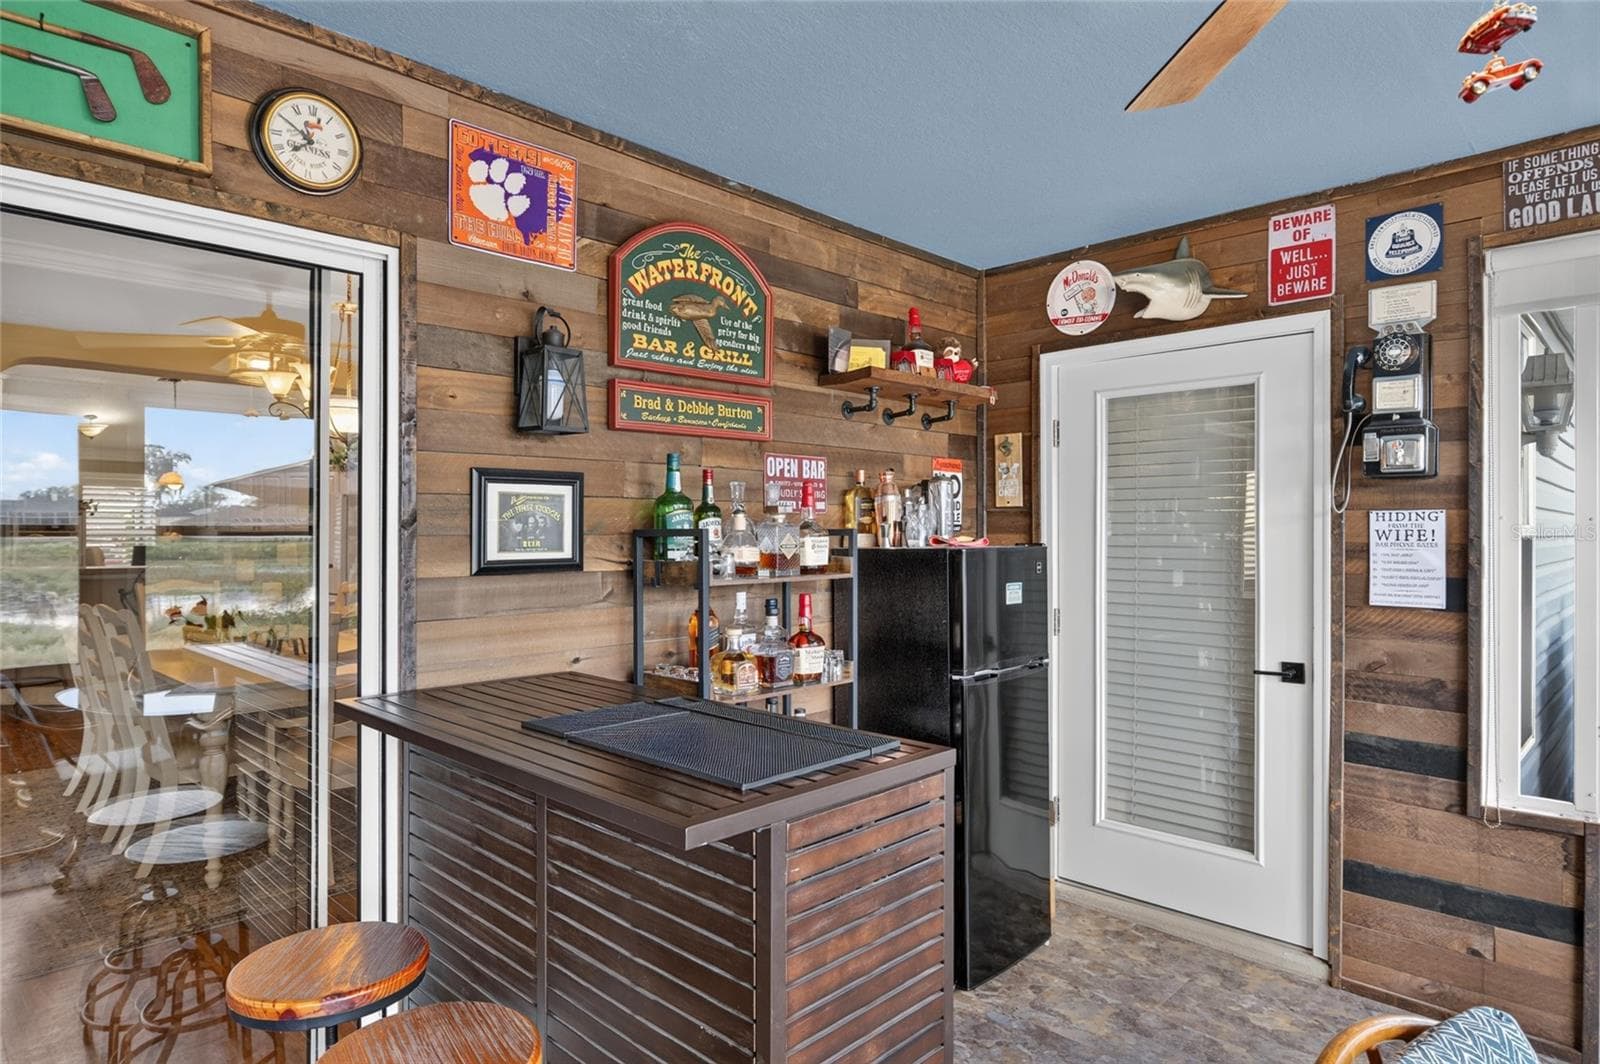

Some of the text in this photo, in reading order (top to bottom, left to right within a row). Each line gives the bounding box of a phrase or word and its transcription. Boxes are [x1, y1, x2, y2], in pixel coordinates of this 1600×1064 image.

[1508, 143, 1599, 172] IF SOMETHING
[1508, 156, 1594, 183] OFFENDS
[1508, 168, 1598, 196] PLEASE LET US
[1524, 191, 1541, 204] WE
[1544, 188, 1565, 200] CAN
[1569, 184, 1587, 197] ALL
[1273, 209, 1331, 232] BEWARE
[1508, 200, 1561, 228] GOOD
[1292, 228, 1311, 242] OF
[679, 243, 701, 259] The
[1280, 247, 1328, 265] WELL...
[1286, 262, 1318, 280] JUST
[627, 258, 758, 318] WATERFRONT
[1277, 276, 1327, 296] BEWARE
[622, 297, 663, 311] great food
[622, 308, 646, 320] drink
[655, 315, 681, 327] spirits
[734, 320, 741, 328] of
[742, 321, 752, 330] the
[622, 321, 672, 336] good friends
[749, 332, 760, 344] big
[632, 333, 753, 367] BAR & GRILL
[633, 394, 753, 420] Brad & Debbie Burton
[767, 456, 825, 480] OPEN BAR
[1375, 511, 1439, 522] HIDING
[1375, 529, 1436, 542] WIFE!
